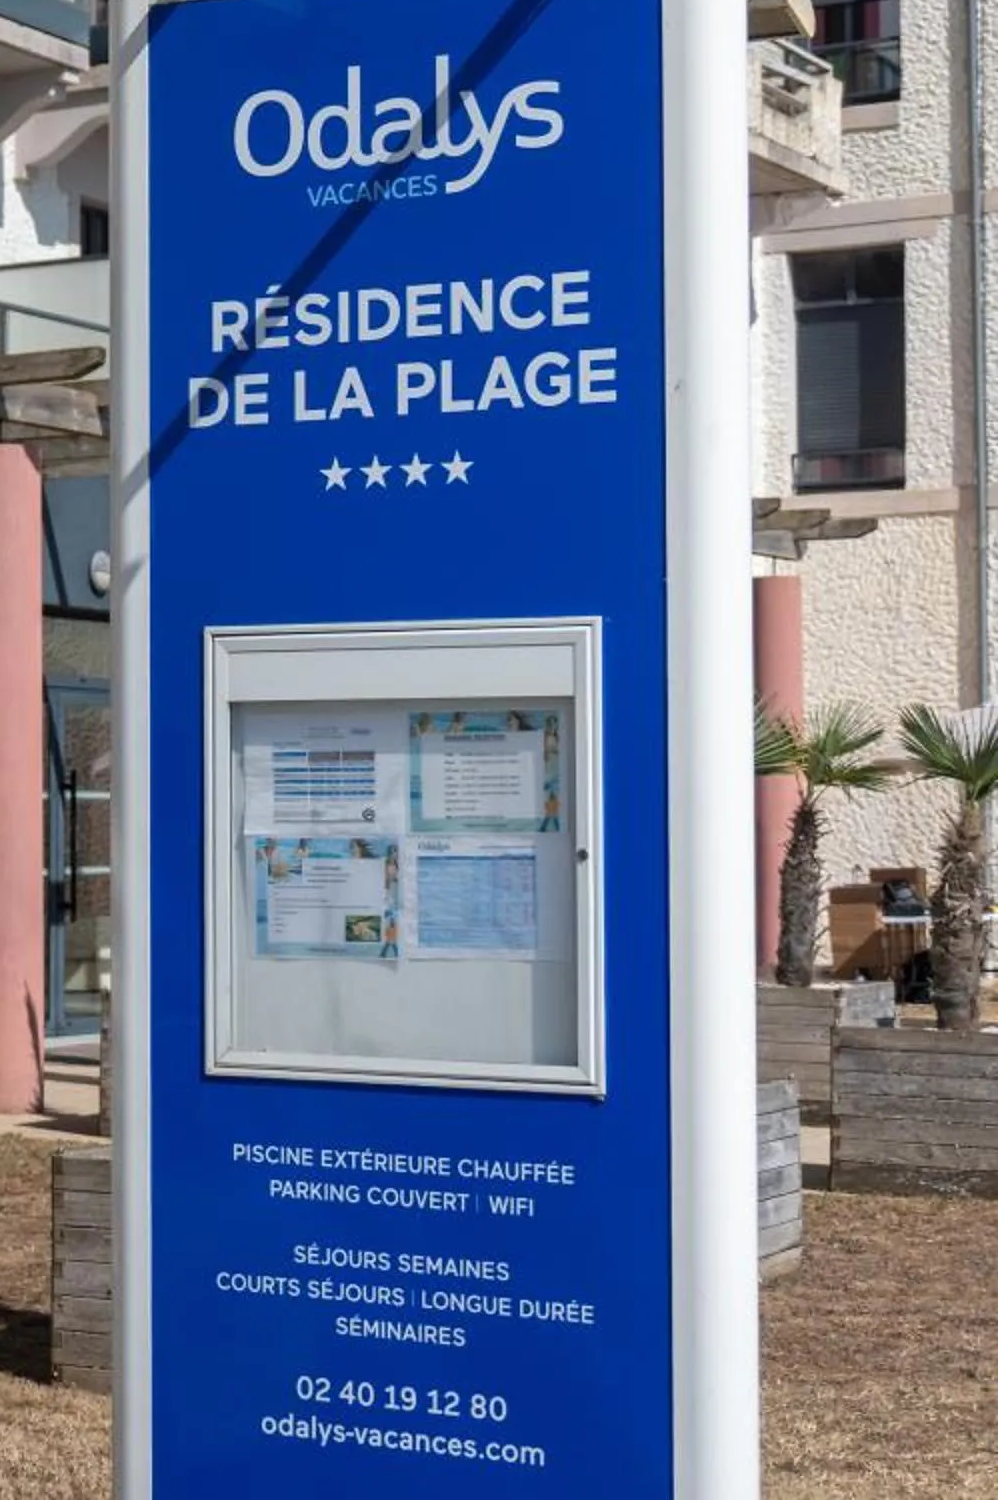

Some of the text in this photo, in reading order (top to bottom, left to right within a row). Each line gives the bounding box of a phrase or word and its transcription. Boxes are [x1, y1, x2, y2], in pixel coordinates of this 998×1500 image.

[233, 54, 565, 194] Odalys
[307, 174, 438, 207] VACANCES
[211, 270, 591, 353] RÉSIDENCE
[188, 347, 618, 429] DE LA PLAGE
[233, 1143, 576, 1185] PISCINE EXTÉRIEURE CHAUFFÉE
[269, 1179, 535, 1217] PARKING COUVERT WIFI
[293, 1242, 510, 1281] SÉJOURS SEMAINES
[216, 1271, 594, 1325] COURTS SÉJOURS LONGUE DURÉE
[335, 1314, 466, 1347] SÉMINAIRES
[296, 1375, 507, 1422] 02 40 19 12 80
[261, 1412, 545, 1467] odalys-vacances.com
